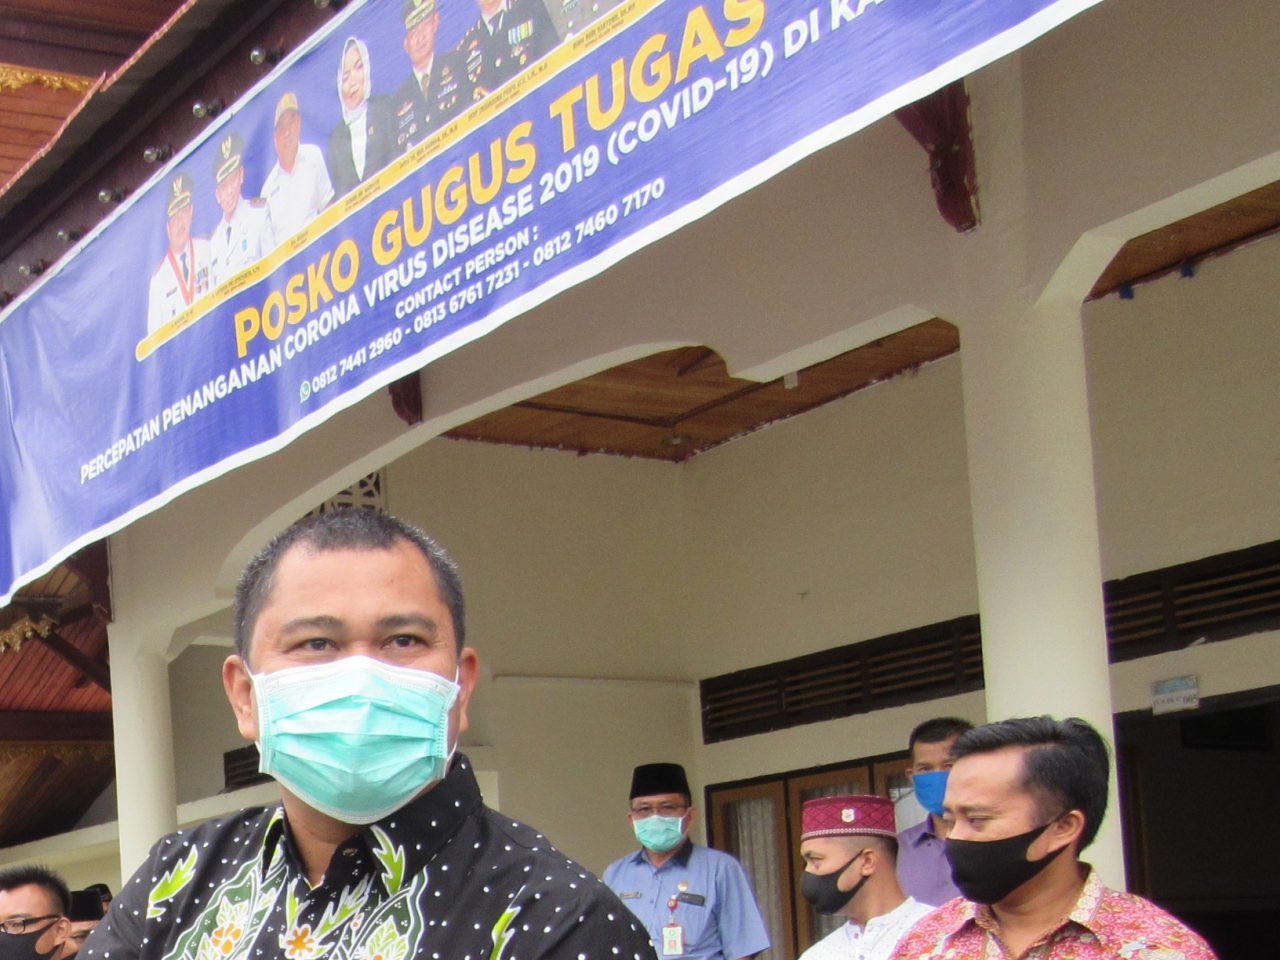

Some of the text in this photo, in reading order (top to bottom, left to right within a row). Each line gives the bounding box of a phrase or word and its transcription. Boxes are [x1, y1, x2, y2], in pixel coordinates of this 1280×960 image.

[80, 415, 160, 485] PERCEPATAN
[162, 345, 282, 431] PENANGANAN
[284, 293, 360, 360] CORONA
[363, 250, 427, 308] VIRUS
[432, 184, 534, 269] DISEASE
[539, 145, 600, 205] 2019
[607, 40, 774, 166] (COVID-19)
[784, 8, 819, 59] DI
[234, 0, 766, 358] POSKO GUGUS TUGAS
[311, 365, 338, 393] 0812
[339, 347, 367, 376] 7441
[369, 327, 403, 360] 2960
[413, 302, 447, 334] 0813
[448, 281, 483, 315] 6761
[486, 259, 519, 295] 7231
[533, 231, 571, 266] 0812
[575, 204, 618, 244] 7460
[622, 177, 665, 217] 7170
[395, 266, 462, 319] CONTACT
